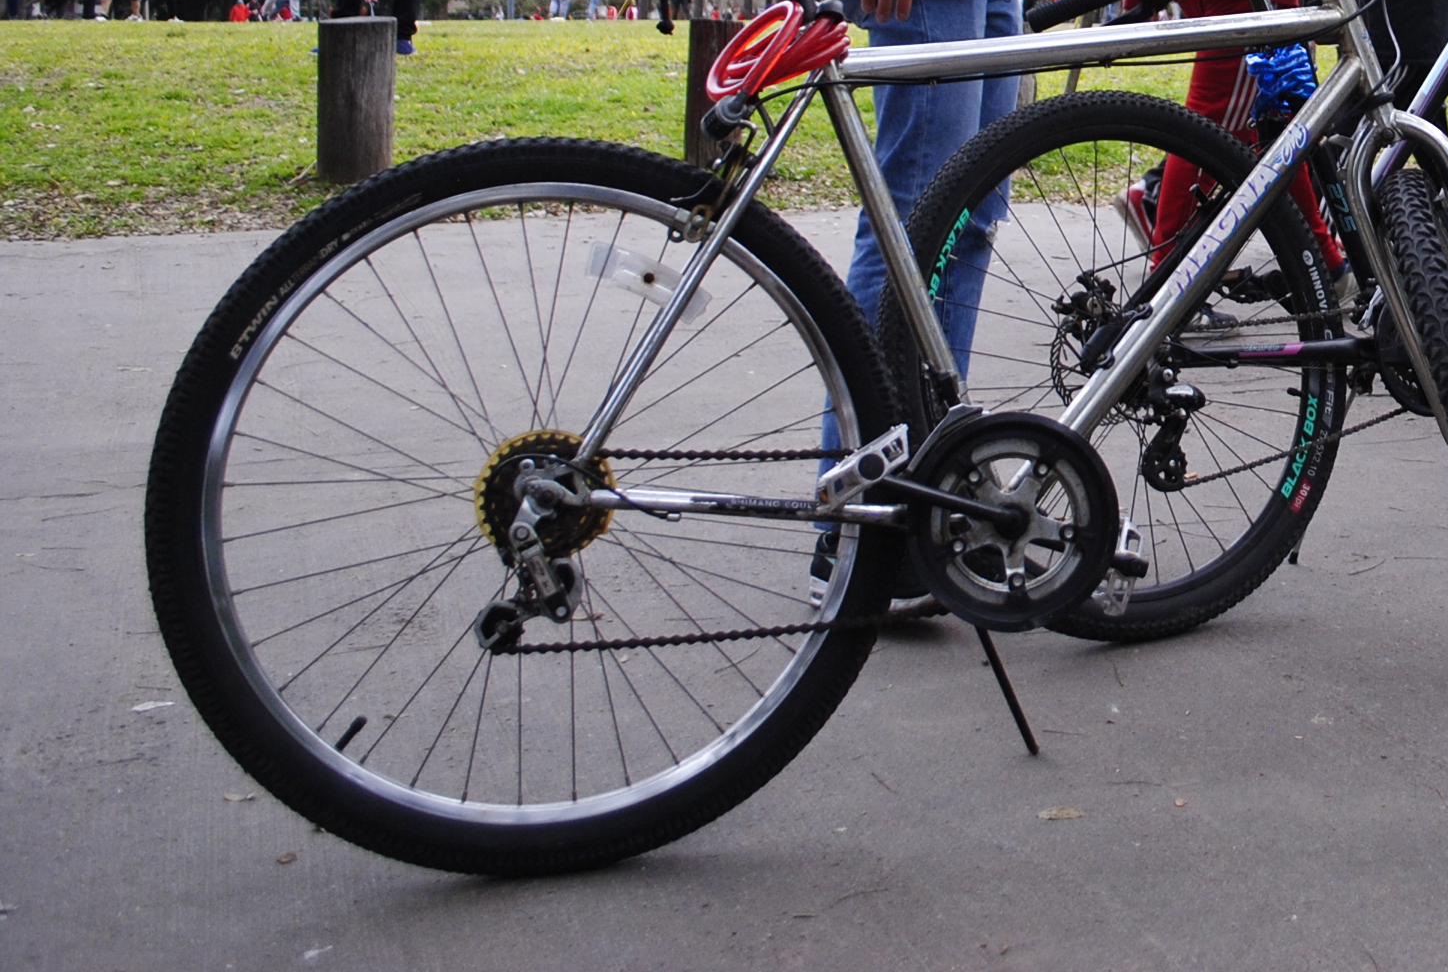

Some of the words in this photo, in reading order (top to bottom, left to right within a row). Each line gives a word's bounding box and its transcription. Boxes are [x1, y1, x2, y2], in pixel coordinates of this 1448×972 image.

[936, 208, 970, 273] BLACK
[928, 272, 940, 305] BO
[1281, 435, 1313, 500] BLACK
[1303, 393, 1319, 436] BOX
